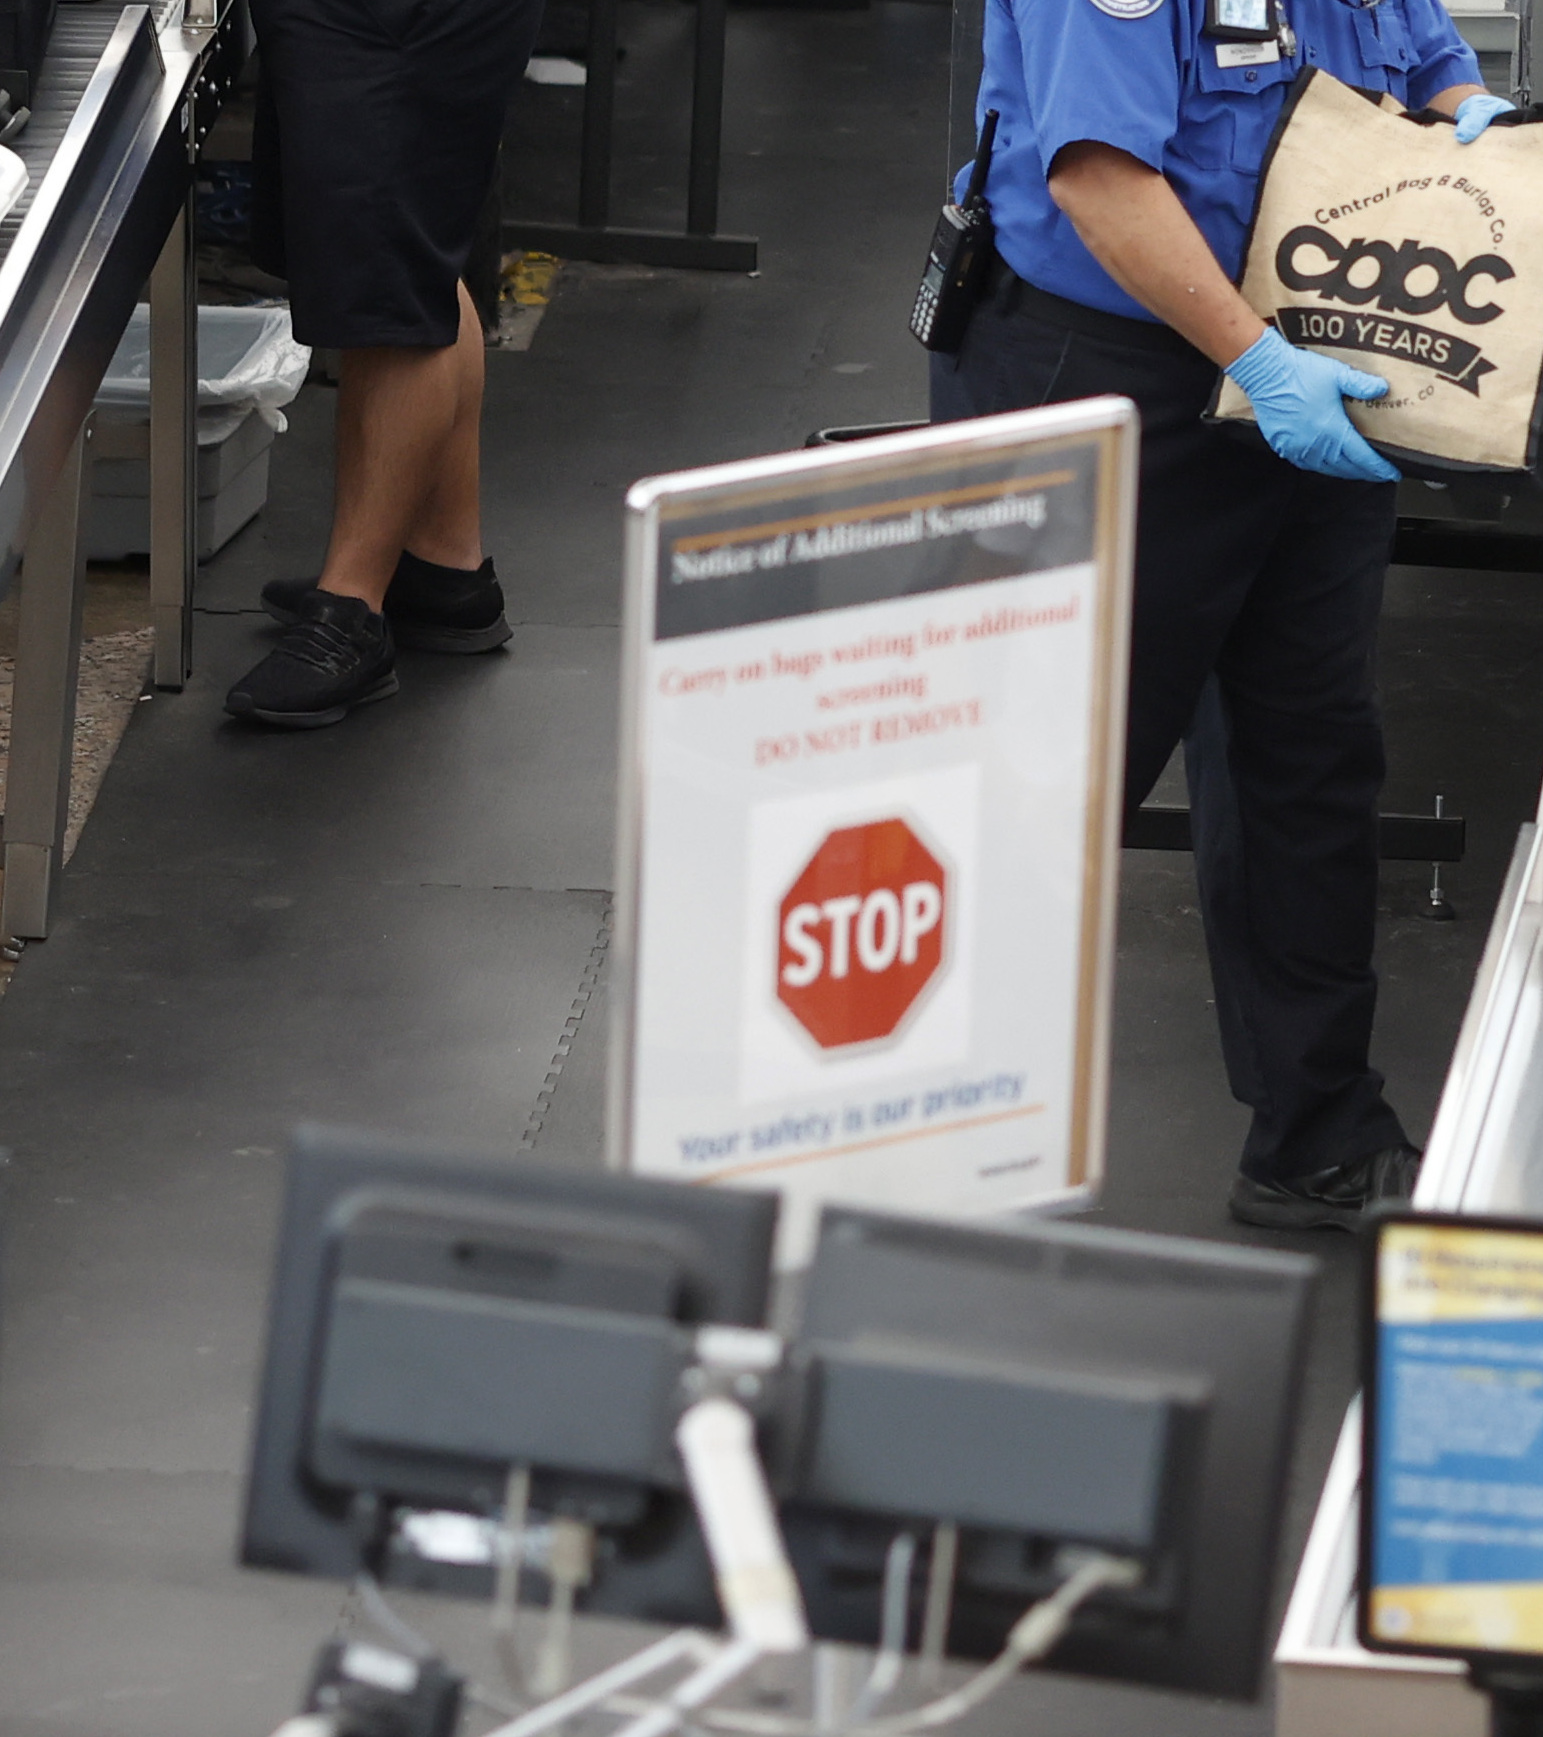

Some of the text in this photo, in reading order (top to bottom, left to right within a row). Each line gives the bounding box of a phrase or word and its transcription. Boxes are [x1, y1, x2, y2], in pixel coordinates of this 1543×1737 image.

[1314, 175, 1506, 251] Central Bag & Burlap Co.
[1300, 313, 1451, 364] 100 YEARS
[1418, 384, 1435, 401] CO
[671, 494, 1048, 583] Notice of Additional Screening
[659, 595, 1080, 698] Carry on bags waiting for additional
[815, 673, 928, 711] screening
[755, 699, 986, 766] DO NOT REMOVE
[781, 880, 944, 988] STOP
[679, 1073, 1026, 1164] Your safety is our priority
